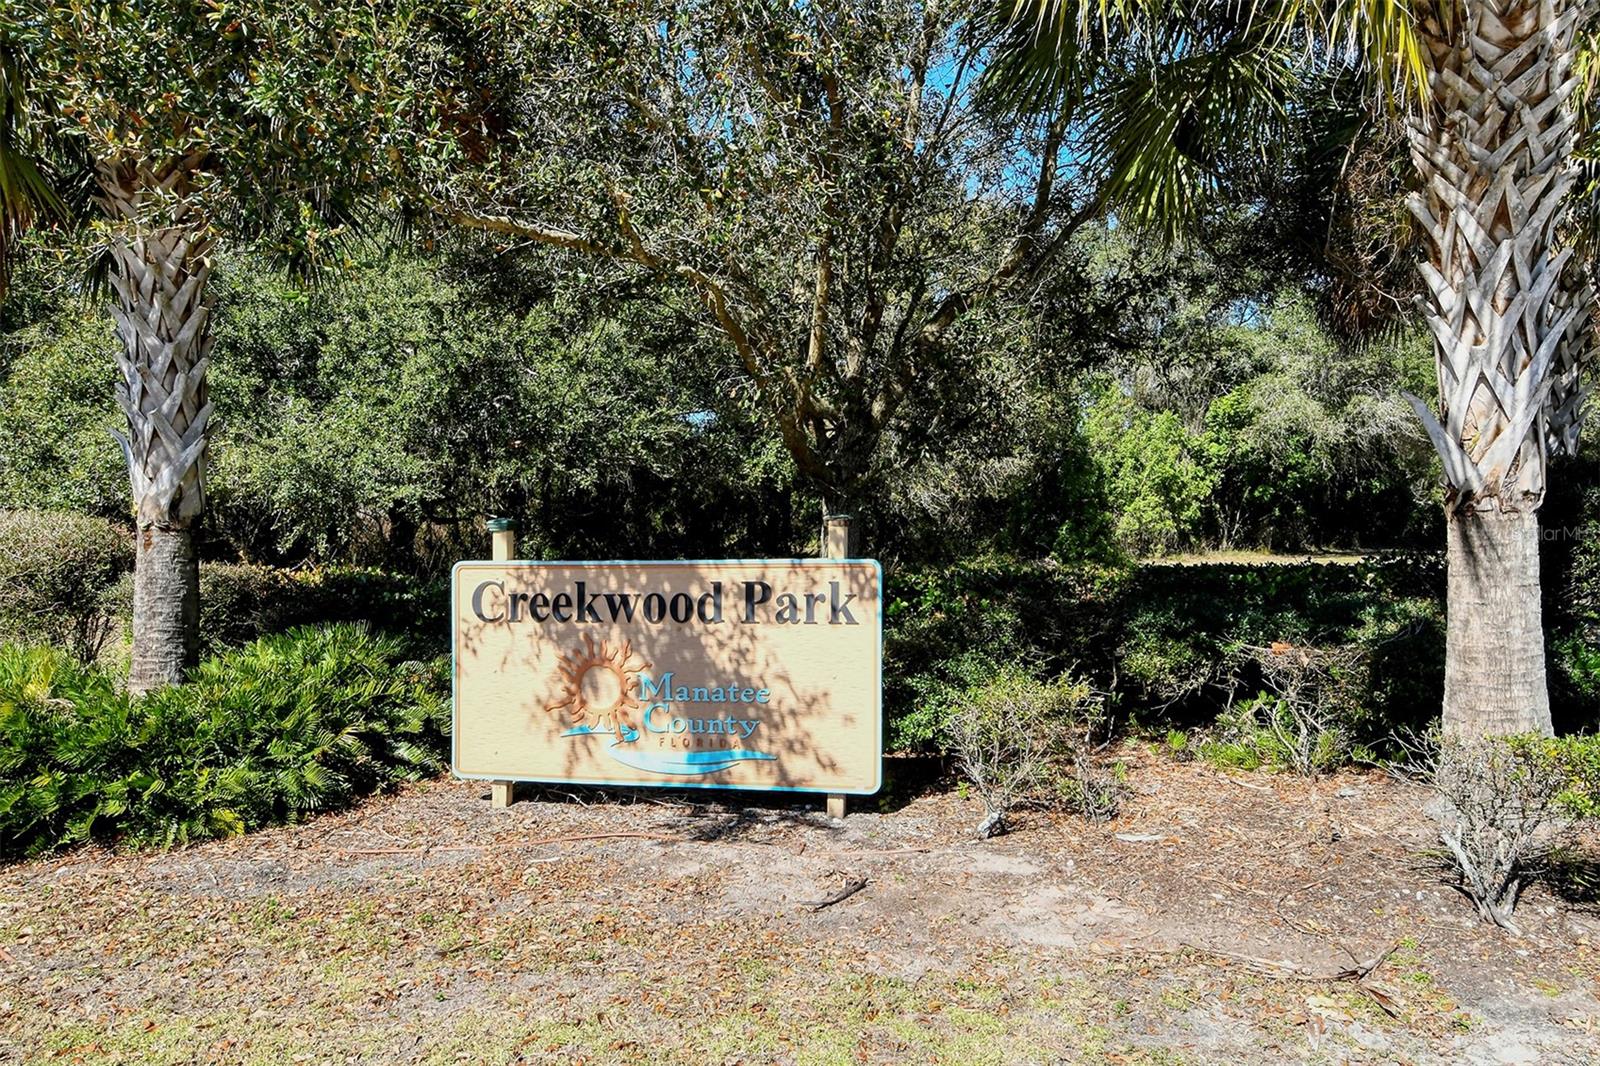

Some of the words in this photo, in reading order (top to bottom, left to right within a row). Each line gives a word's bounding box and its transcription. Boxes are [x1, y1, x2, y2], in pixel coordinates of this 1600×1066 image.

[471, 580, 725, 625] Creekwood
[740, 580, 860, 626] Park
[638, 672, 771, 704] Manatee
[643, 703, 760, 739] County
[659, 737, 741, 750] FLORIDA
